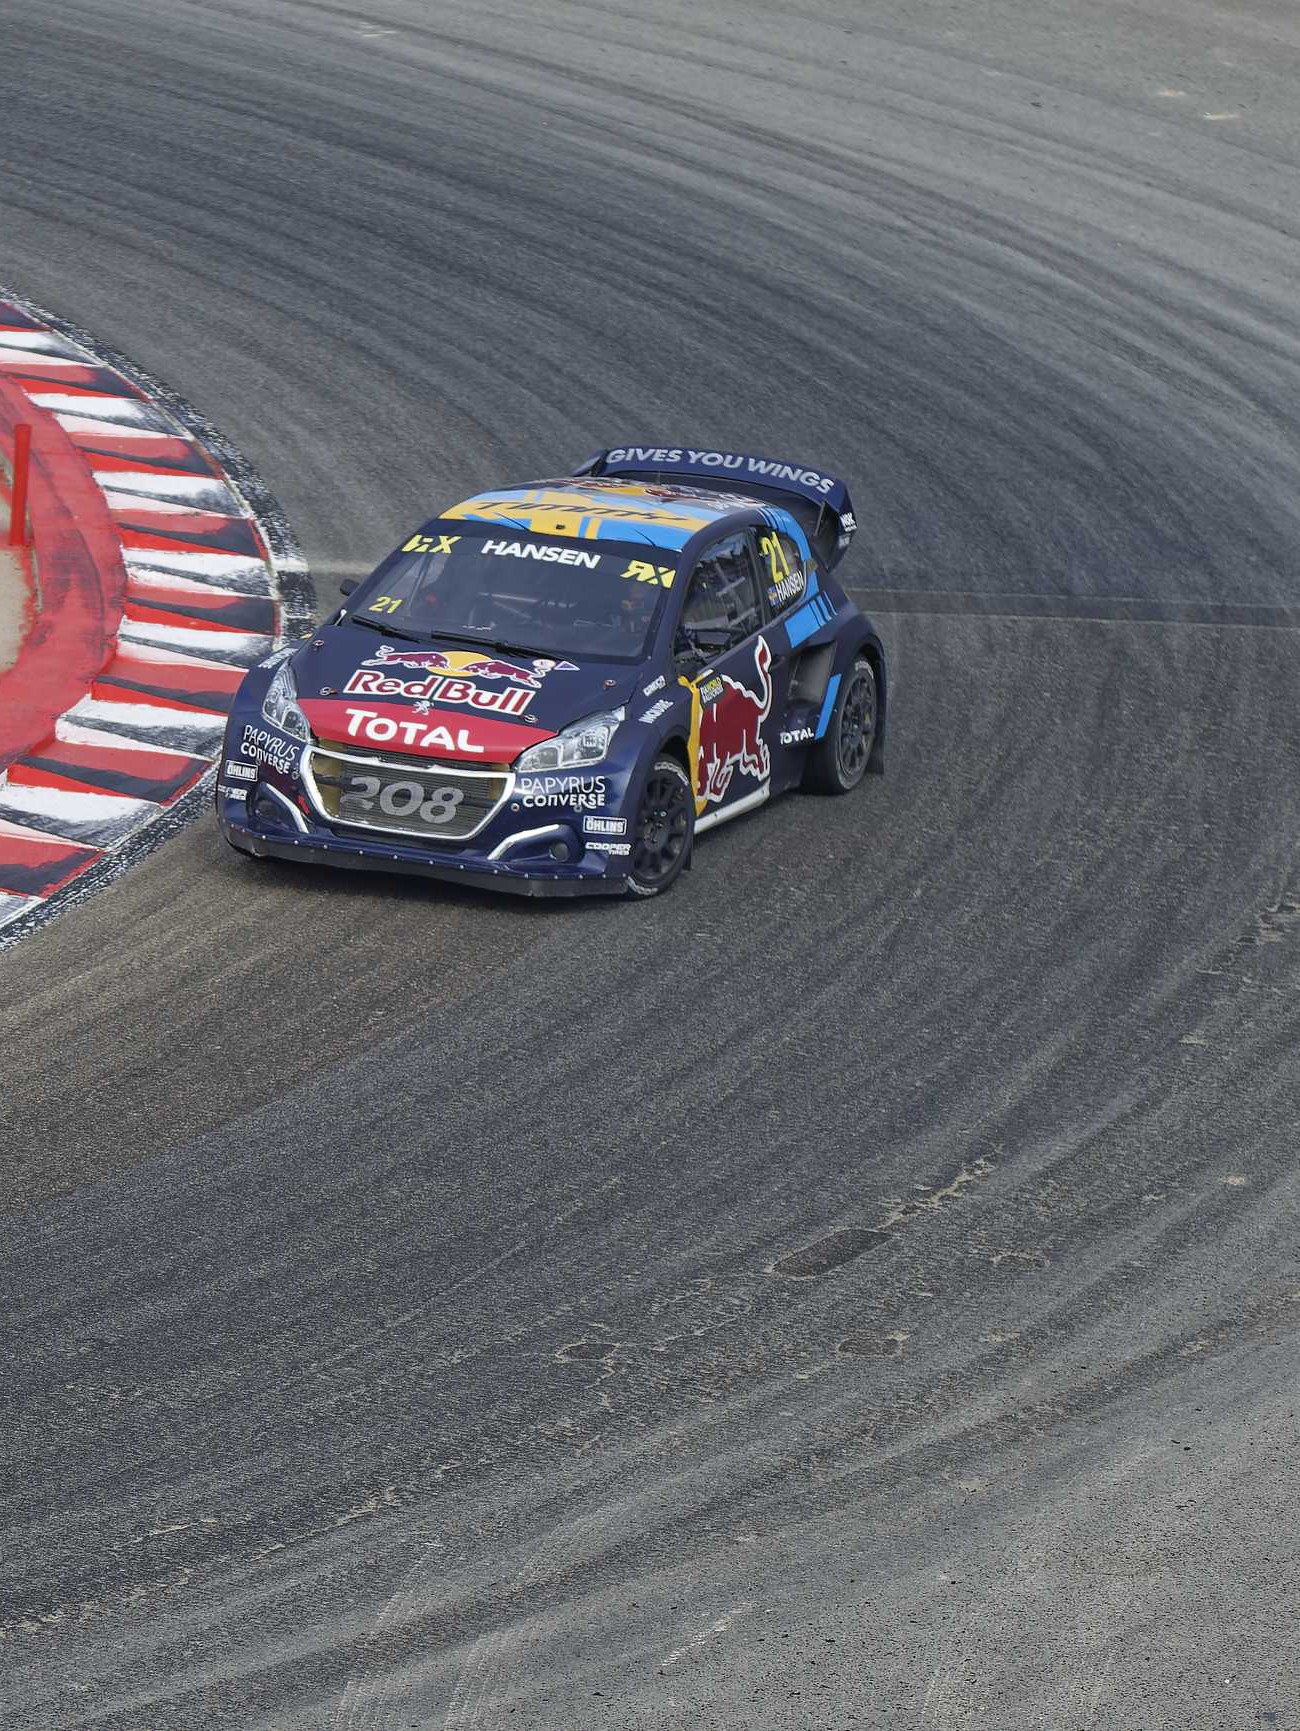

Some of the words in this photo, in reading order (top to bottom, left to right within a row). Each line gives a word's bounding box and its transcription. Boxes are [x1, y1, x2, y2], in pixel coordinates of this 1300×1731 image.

[605, 448, 684, 464] GIVES
[687, 450, 744, 469] YOU
[747, 458, 835, 494] WINGS
[480, 540, 602, 569] HANSEN
[761, 531, 791, 584] 21
[775, 570, 805, 602] HANSEN
[368, 596, 403, 614] 21
[243, 724, 300, 762] PAPYRUS
[345, 708, 485, 753] TOTAL
[780, 727, 815, 745] TOTAL
[339, 776, 465, 824] 208
[520, 775, 606, 794] PAPYRUS
